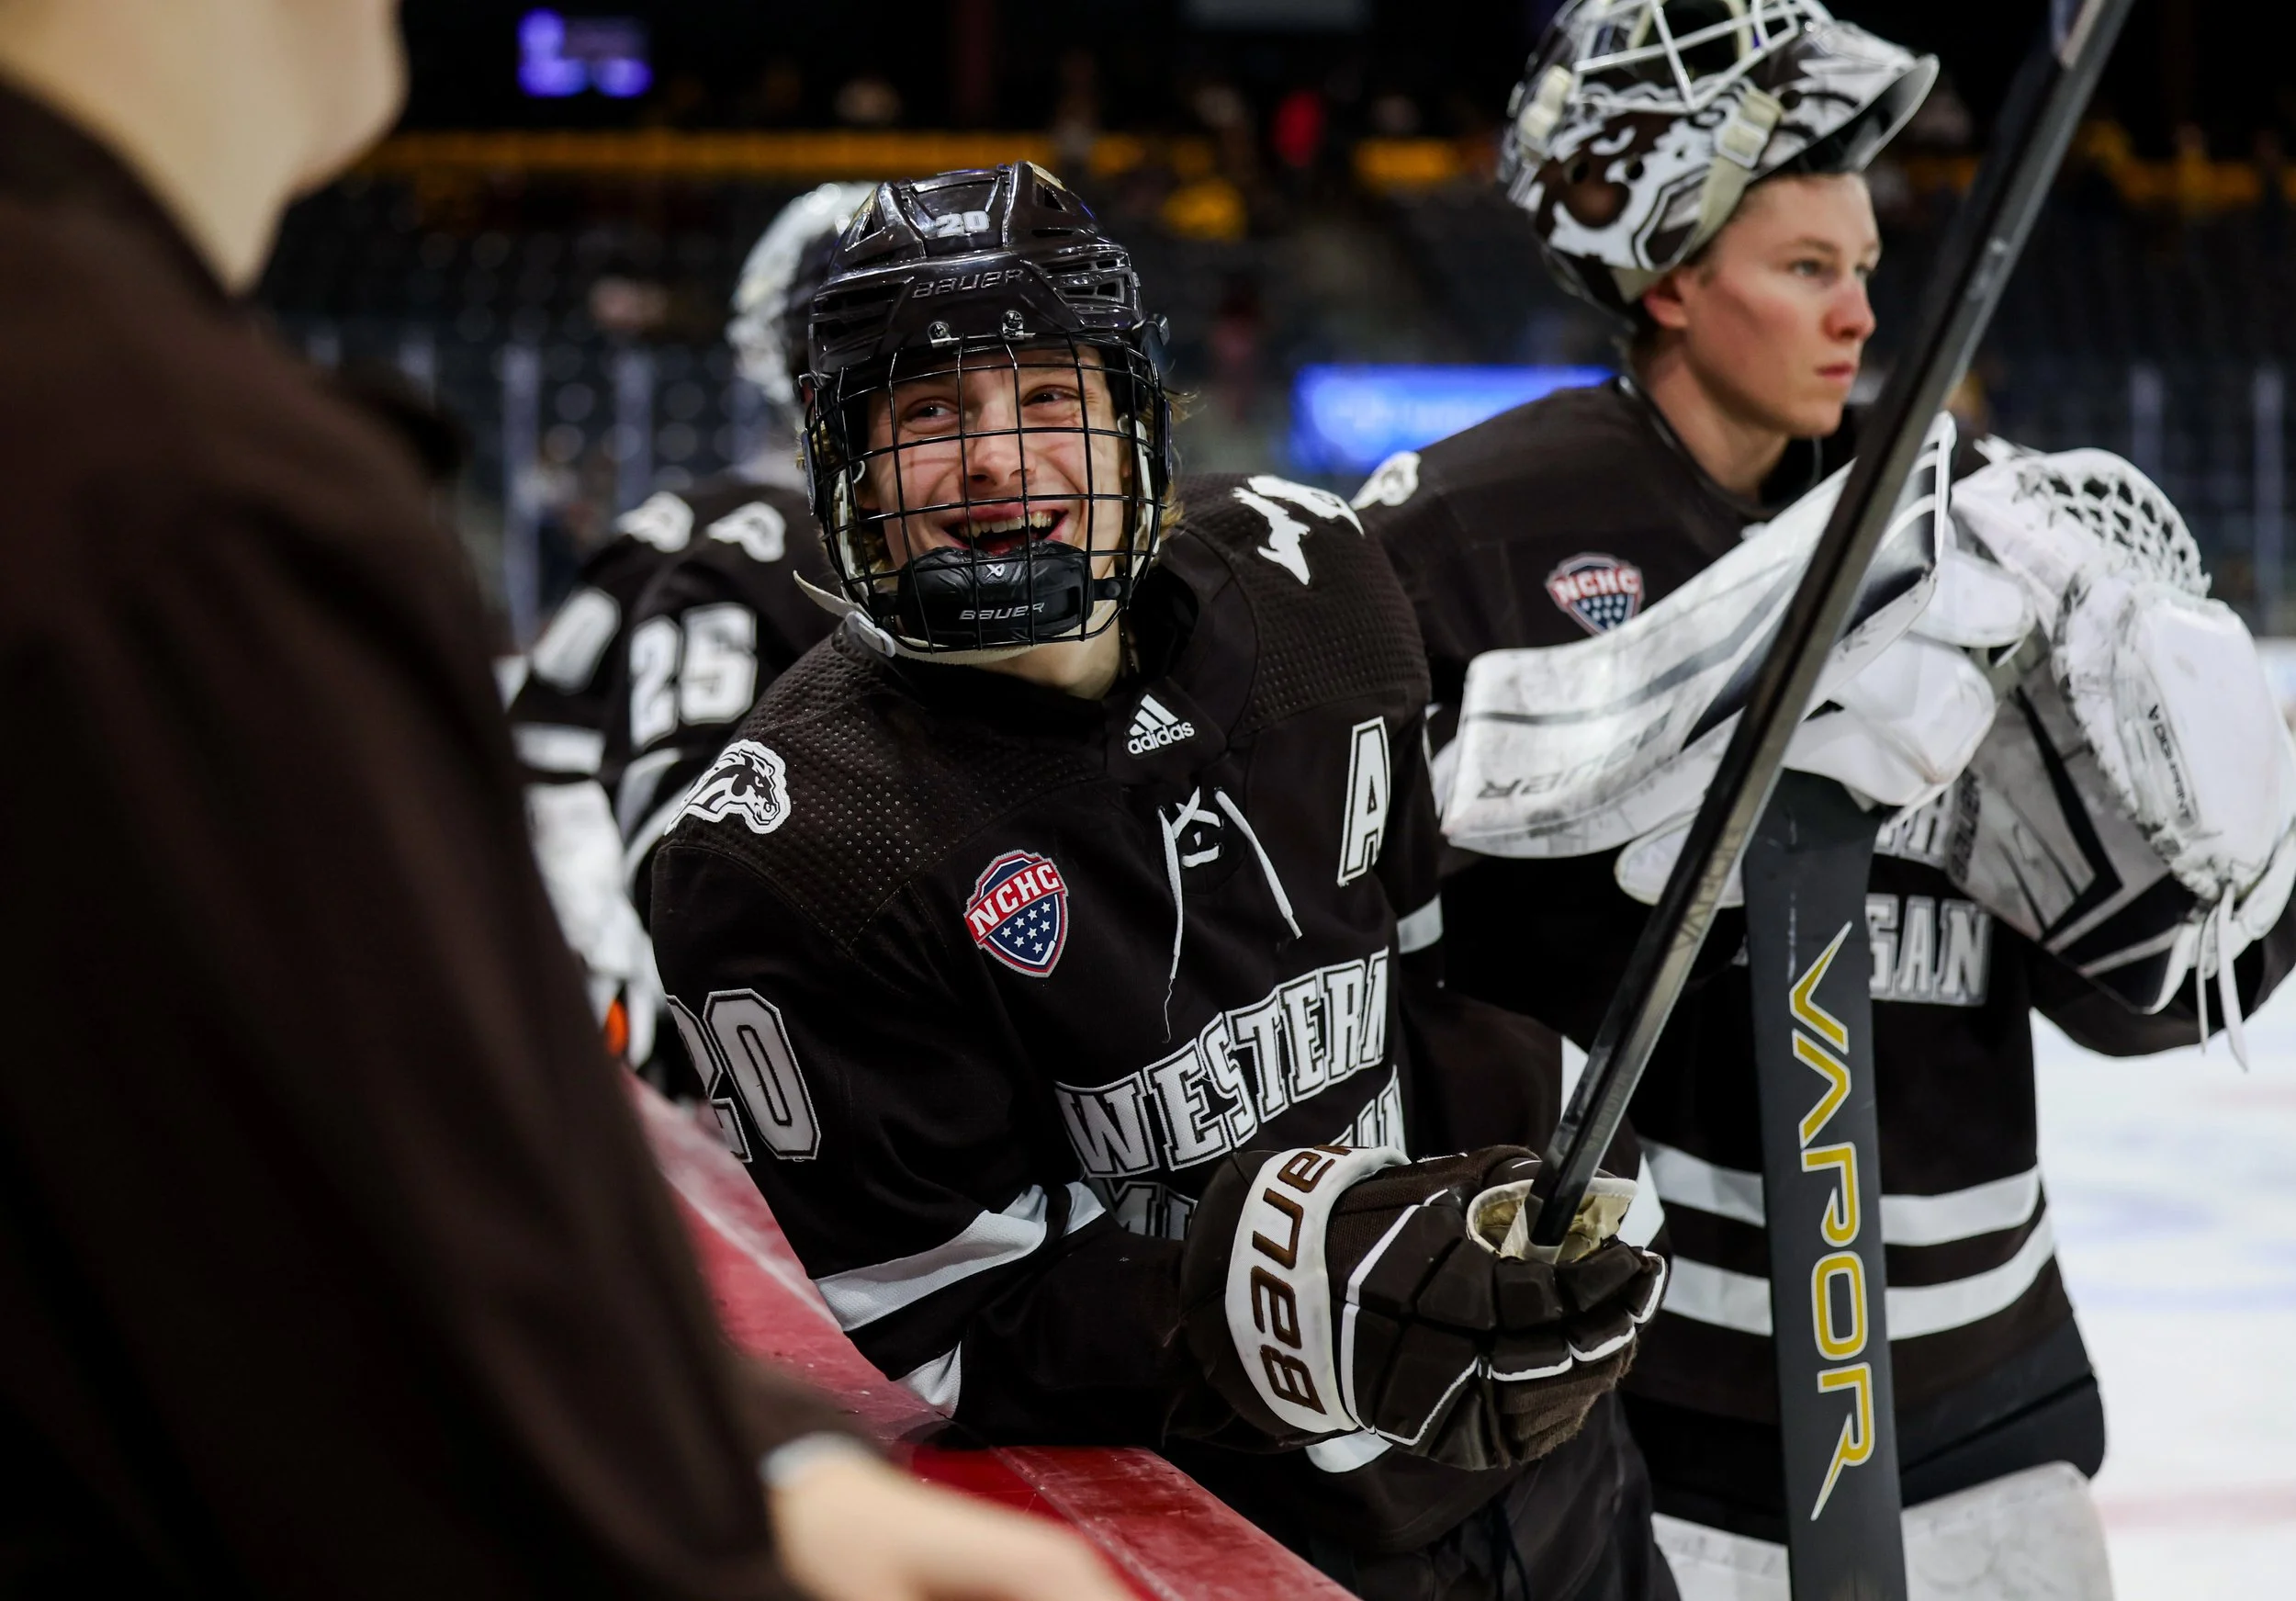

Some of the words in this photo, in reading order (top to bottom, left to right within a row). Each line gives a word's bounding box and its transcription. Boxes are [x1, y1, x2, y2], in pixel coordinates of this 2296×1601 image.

[935, 210, 990, 238] 20
[1548, 567, 1641, 606] NCHC
[627, 602, 758, 753] 25
[1127, 721, 1195, 755] adidas
[1337, 716, 1390, 887] A
[968, 863, 1062, 937] NCHC
[667, 988, 821, 1163] 20
[1789, 921, 1875, 1521] VAPOR
